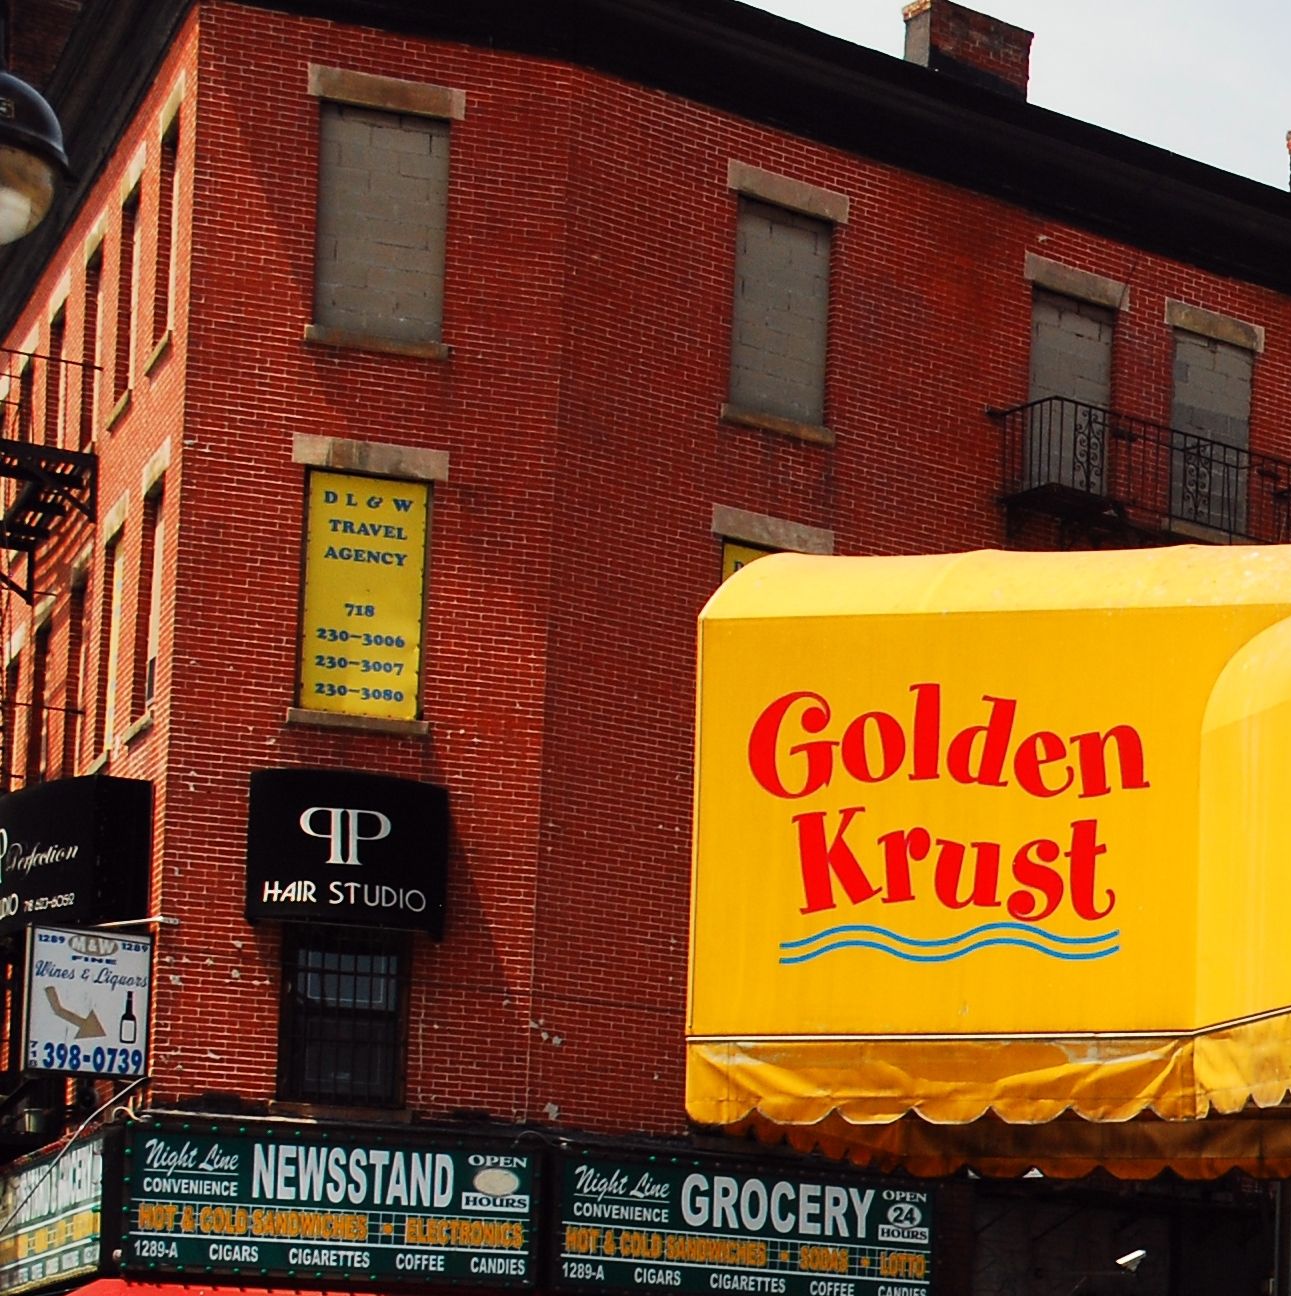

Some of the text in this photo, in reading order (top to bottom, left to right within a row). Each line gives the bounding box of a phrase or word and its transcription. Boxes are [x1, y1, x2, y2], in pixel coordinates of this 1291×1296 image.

[324, 491, 413, 512] D L & W
[329, 519, 407, 540] TRAVEL
[324, 547, 407, 566] AGENCY
[344, 603, 375, 617] 718
[316, 628, 405, 647] 230-3006
[315, 655, 404, 675] 230-3007
[315, 683, 404, 701] 230-3080
[748, 683, 1150, 799] Golden
[791, 806, 1116, 922] Krust
[262, 880, 426, 912] HAIR STUDIO
[38, 933, 149, 955] 1289 M&W 1289
[71, 955, 117, 965] FINE
[35, 959, 148, 992] Wines & Liquors
[43, 1042, 143, 1075] 398-0739
[145, 1138, 239, 1177] Night Line
[468, 1154, 528, 1168] OPEN
[252, 1143, 454, 1208] NEWSSTAND
[574, 1164, 670, 1201] Night Line
[143, 1177, 239, 1197] CONVENIENCE
[882, 1190, 927, 1202] OPEN
[464, 1196, 527, 1209] HOURS
[573, 1202, 669, 1223] CONVENIENCE
[681, 1173, 875, 1238] GROCERY
[138, 1203, 524, 1248] HOT & COLD SANDWICHES ELECTRONICS
[891, 1206, 917, 1224] 24
[881, 1227, 927, 1241] HOURS
[134, 1239, 525, 1275] 1289-A CIGARS CIGARETTES COFFEE CANDIES
[565, 1226, 600, 1254] HOT
[620, 1231, 663, 1259] COLD
[665, 1235, 767, 1268] SANDWICHES
[800, 1245, 849, 1273] SODAS
[879, 1251, 926, 1279] LOTTO
[562, 1262, 604, 1280] 1289-A
[634, 1267, 681, 1286] CIGARS
[709, 1273, 786, 1293] CIGARETTES
